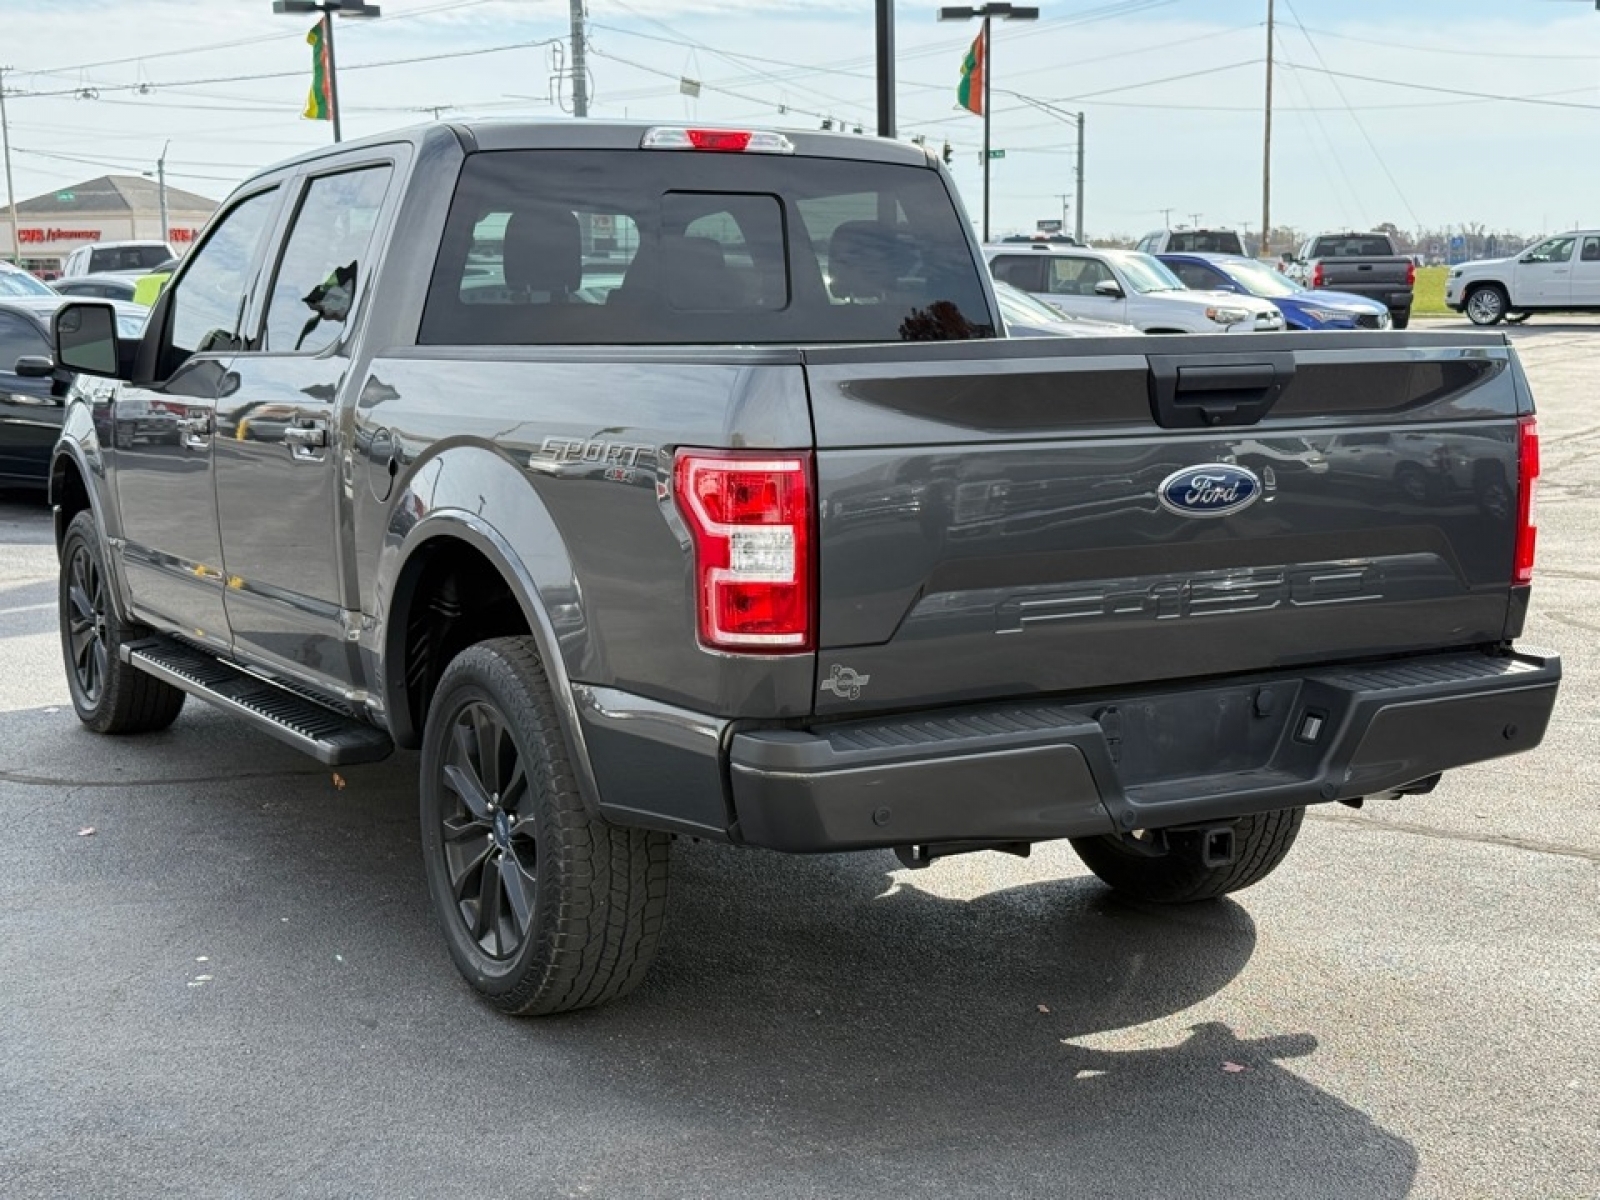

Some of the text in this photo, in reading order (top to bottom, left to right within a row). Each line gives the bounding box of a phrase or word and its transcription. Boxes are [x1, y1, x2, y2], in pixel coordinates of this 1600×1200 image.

[540, 435, 656, 466] SPORT
[1185, 475, 1239, 505] Ford
[995, 565, 1385, 634] F-150
